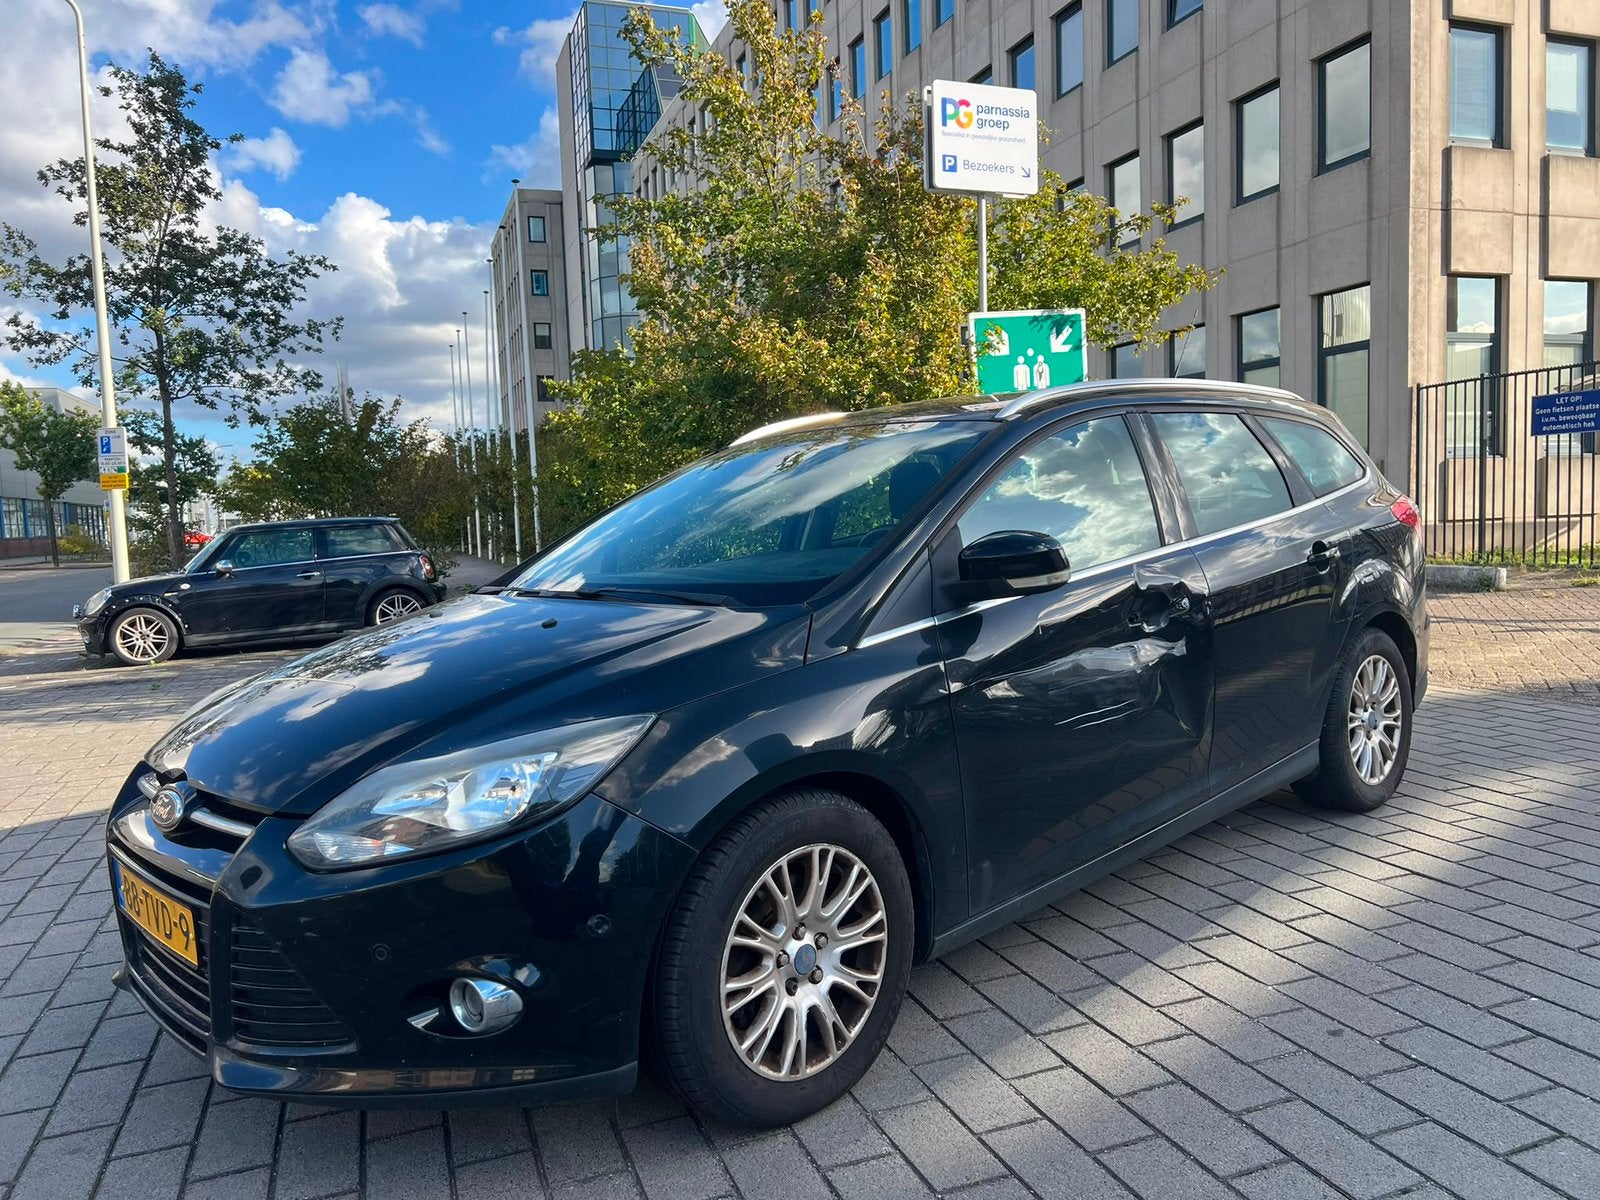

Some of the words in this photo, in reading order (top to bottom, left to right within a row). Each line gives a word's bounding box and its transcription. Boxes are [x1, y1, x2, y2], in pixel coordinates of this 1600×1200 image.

[941, 97, 973, 129] PG
[976, 104, 1030, 119] parnassia
[976, 118, 1010, 131] groep
[963, 159, 1015, 174] Bezoekers
[1570, 395, 1583, 403] OP!
[1552, 405, 1575, 413] fietsen
[1575, 403, 1600, 412] plaatse
[1558, 412, 1597, 421] beweegbaar
[1542, 421, 1582, 431] automatisch
[1583, 420, 1596, 428] hek
[153, 794, 171, 820] Ford
[123, 873, 192, 951] 88-TVD-9
